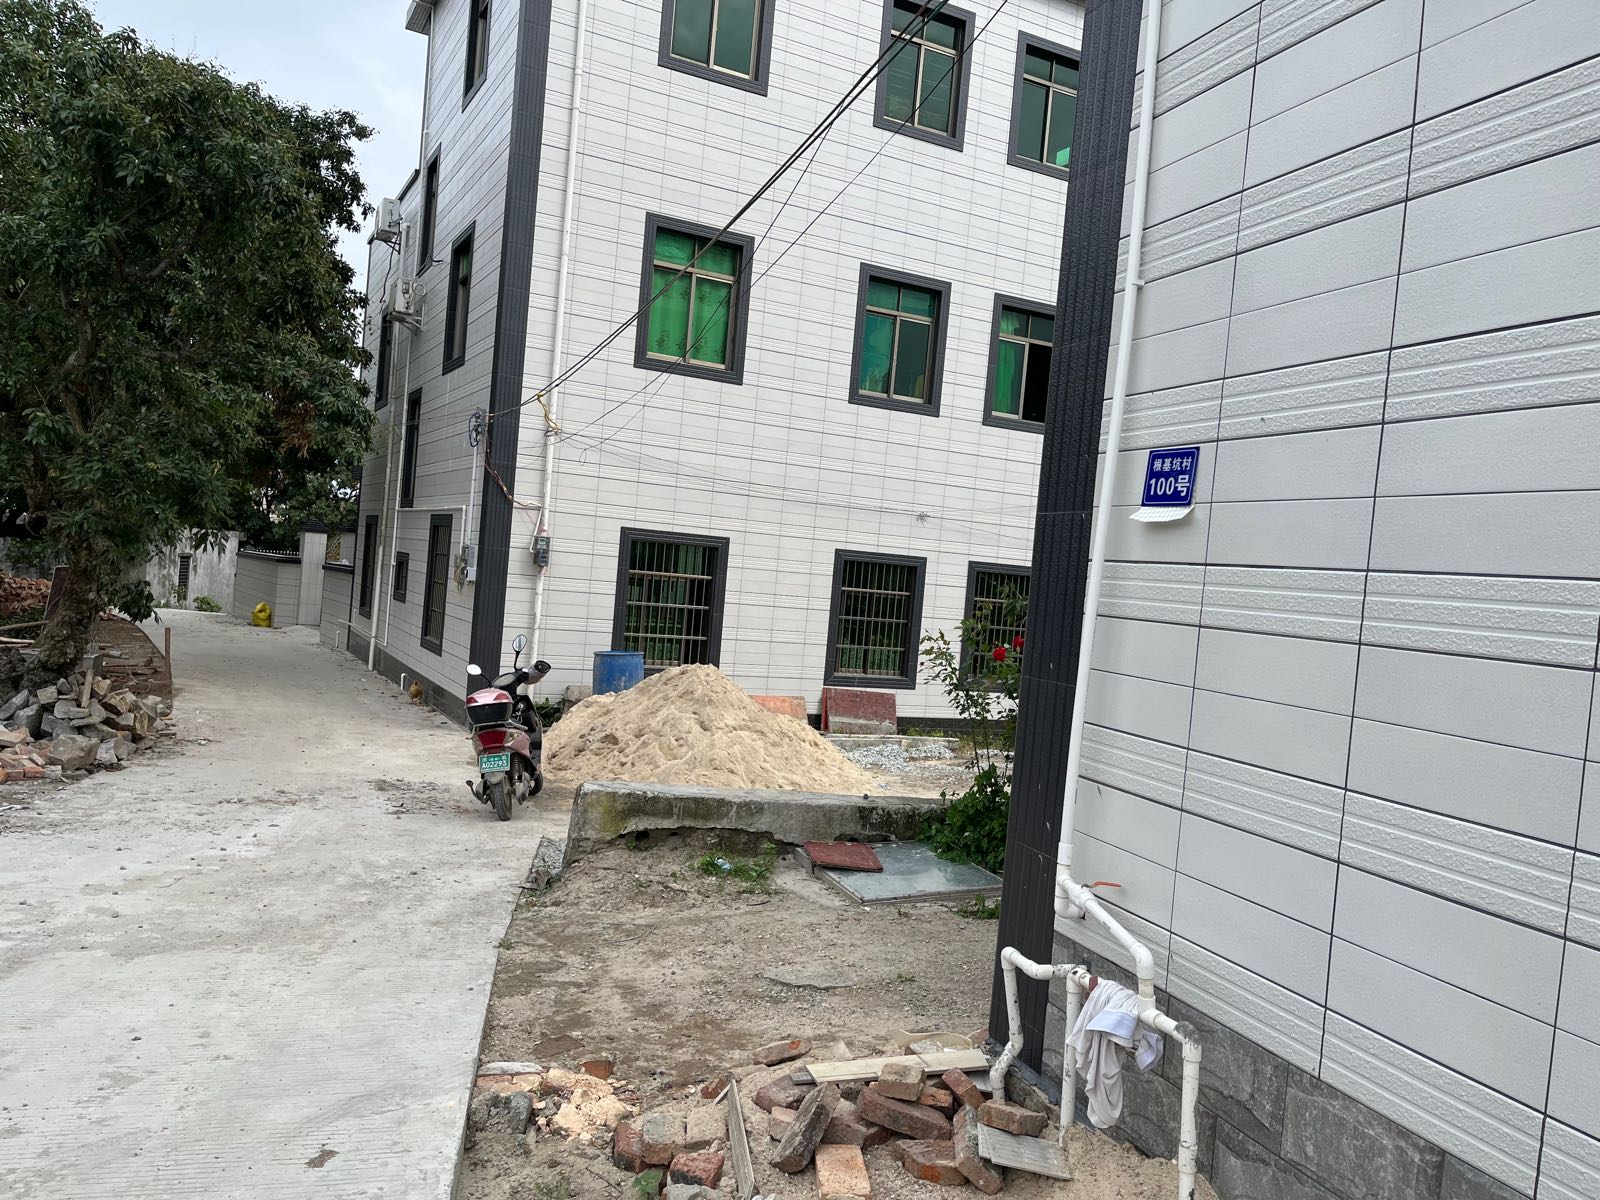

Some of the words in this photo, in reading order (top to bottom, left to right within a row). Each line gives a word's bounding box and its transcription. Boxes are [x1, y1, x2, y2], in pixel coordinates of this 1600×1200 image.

[1153, 456, 1192, 472] 根基坑村
[1149, 475, 1190, 496] 100号
